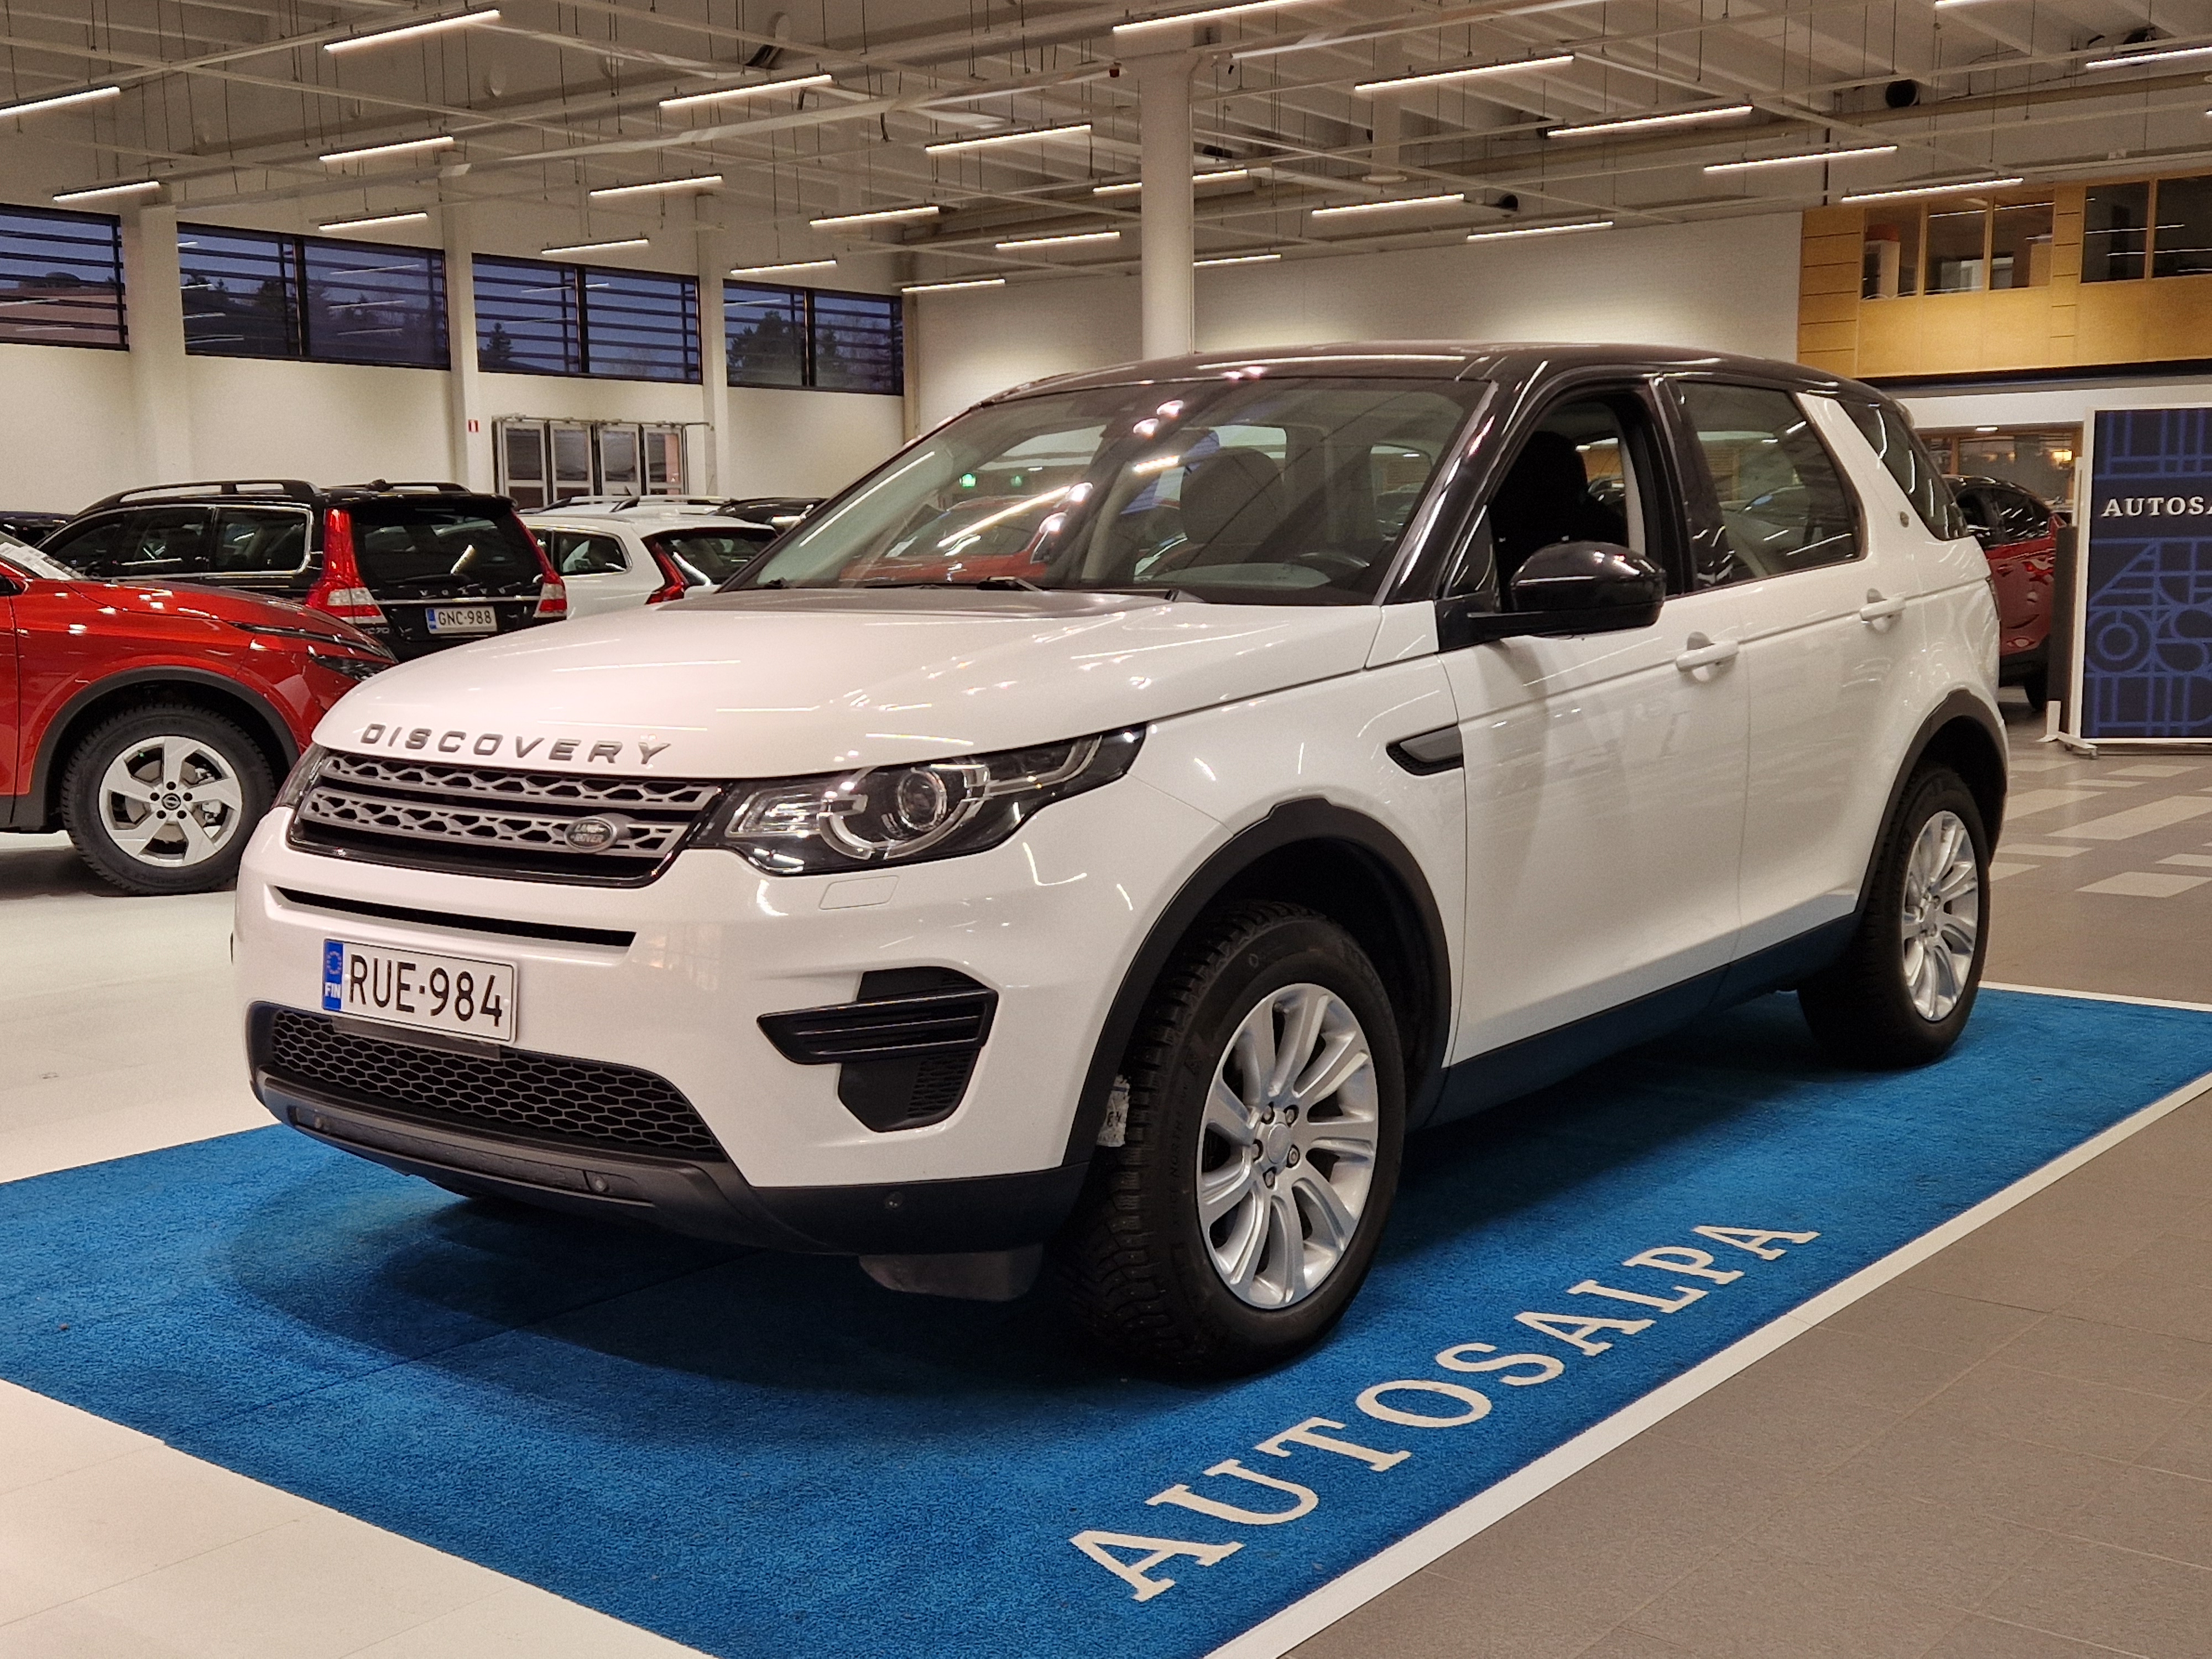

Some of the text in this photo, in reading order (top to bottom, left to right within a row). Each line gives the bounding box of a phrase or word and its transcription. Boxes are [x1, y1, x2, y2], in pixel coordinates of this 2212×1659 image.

[2101, 496, 2212, 517] AUTOS
[419, 587, 506, 596] VOLVO
[438, 609, 492, 625] GNC-988
[361, 723, 671, 765] DISCOVERY
[325, 982, 341, 999] FIN
[349, 954, 502, 1027] RUE-984
[1070, 1220, 1820, 1601] AUTOSALPA
